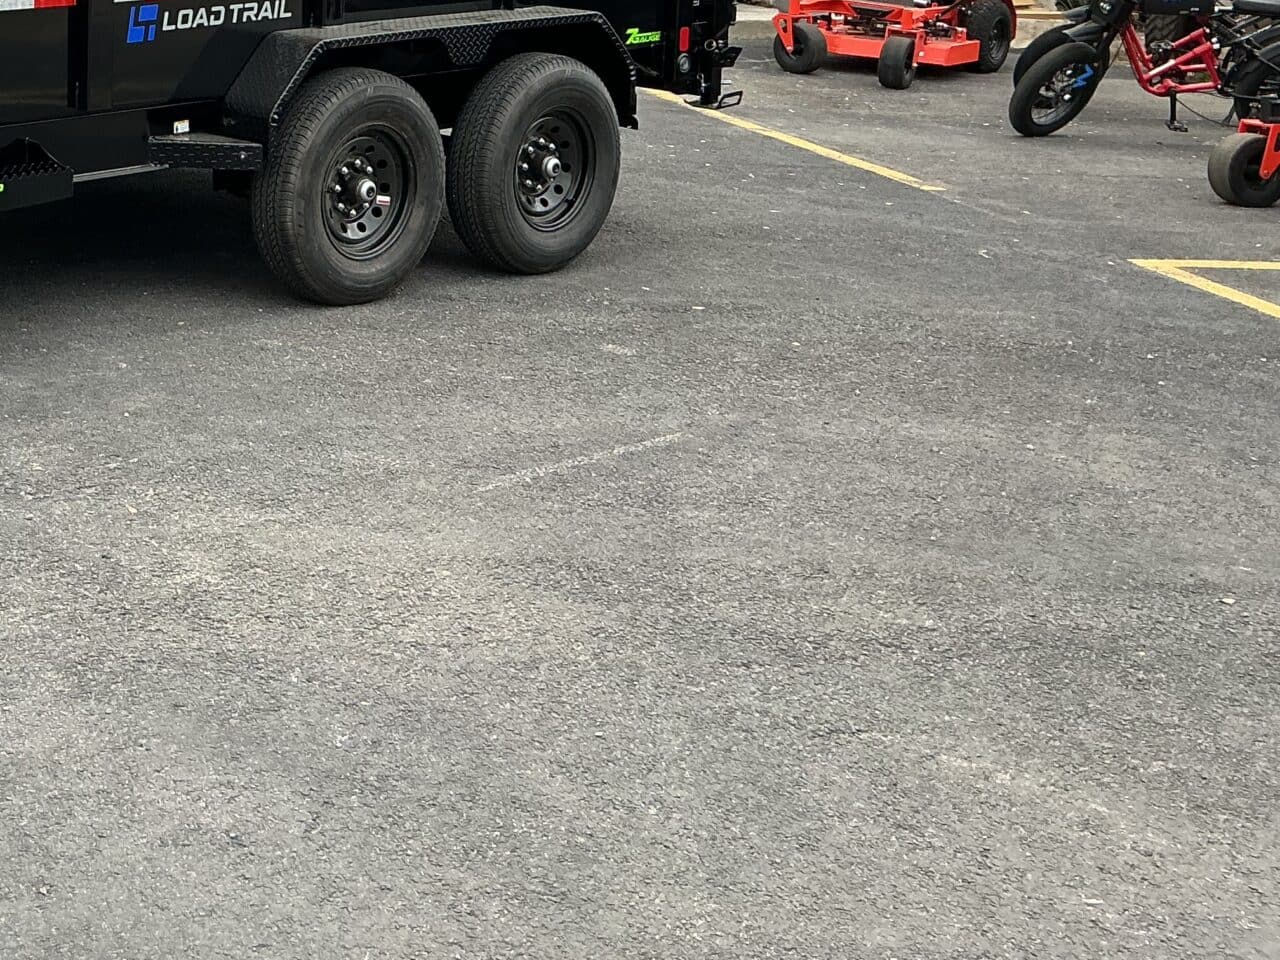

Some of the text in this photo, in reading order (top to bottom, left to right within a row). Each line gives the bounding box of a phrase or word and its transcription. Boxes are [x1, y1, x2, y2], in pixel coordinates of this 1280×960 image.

[162, 0, 293, 32] LOAD TRAIL
[625, 27, 662, 45] 7 GAUGE
